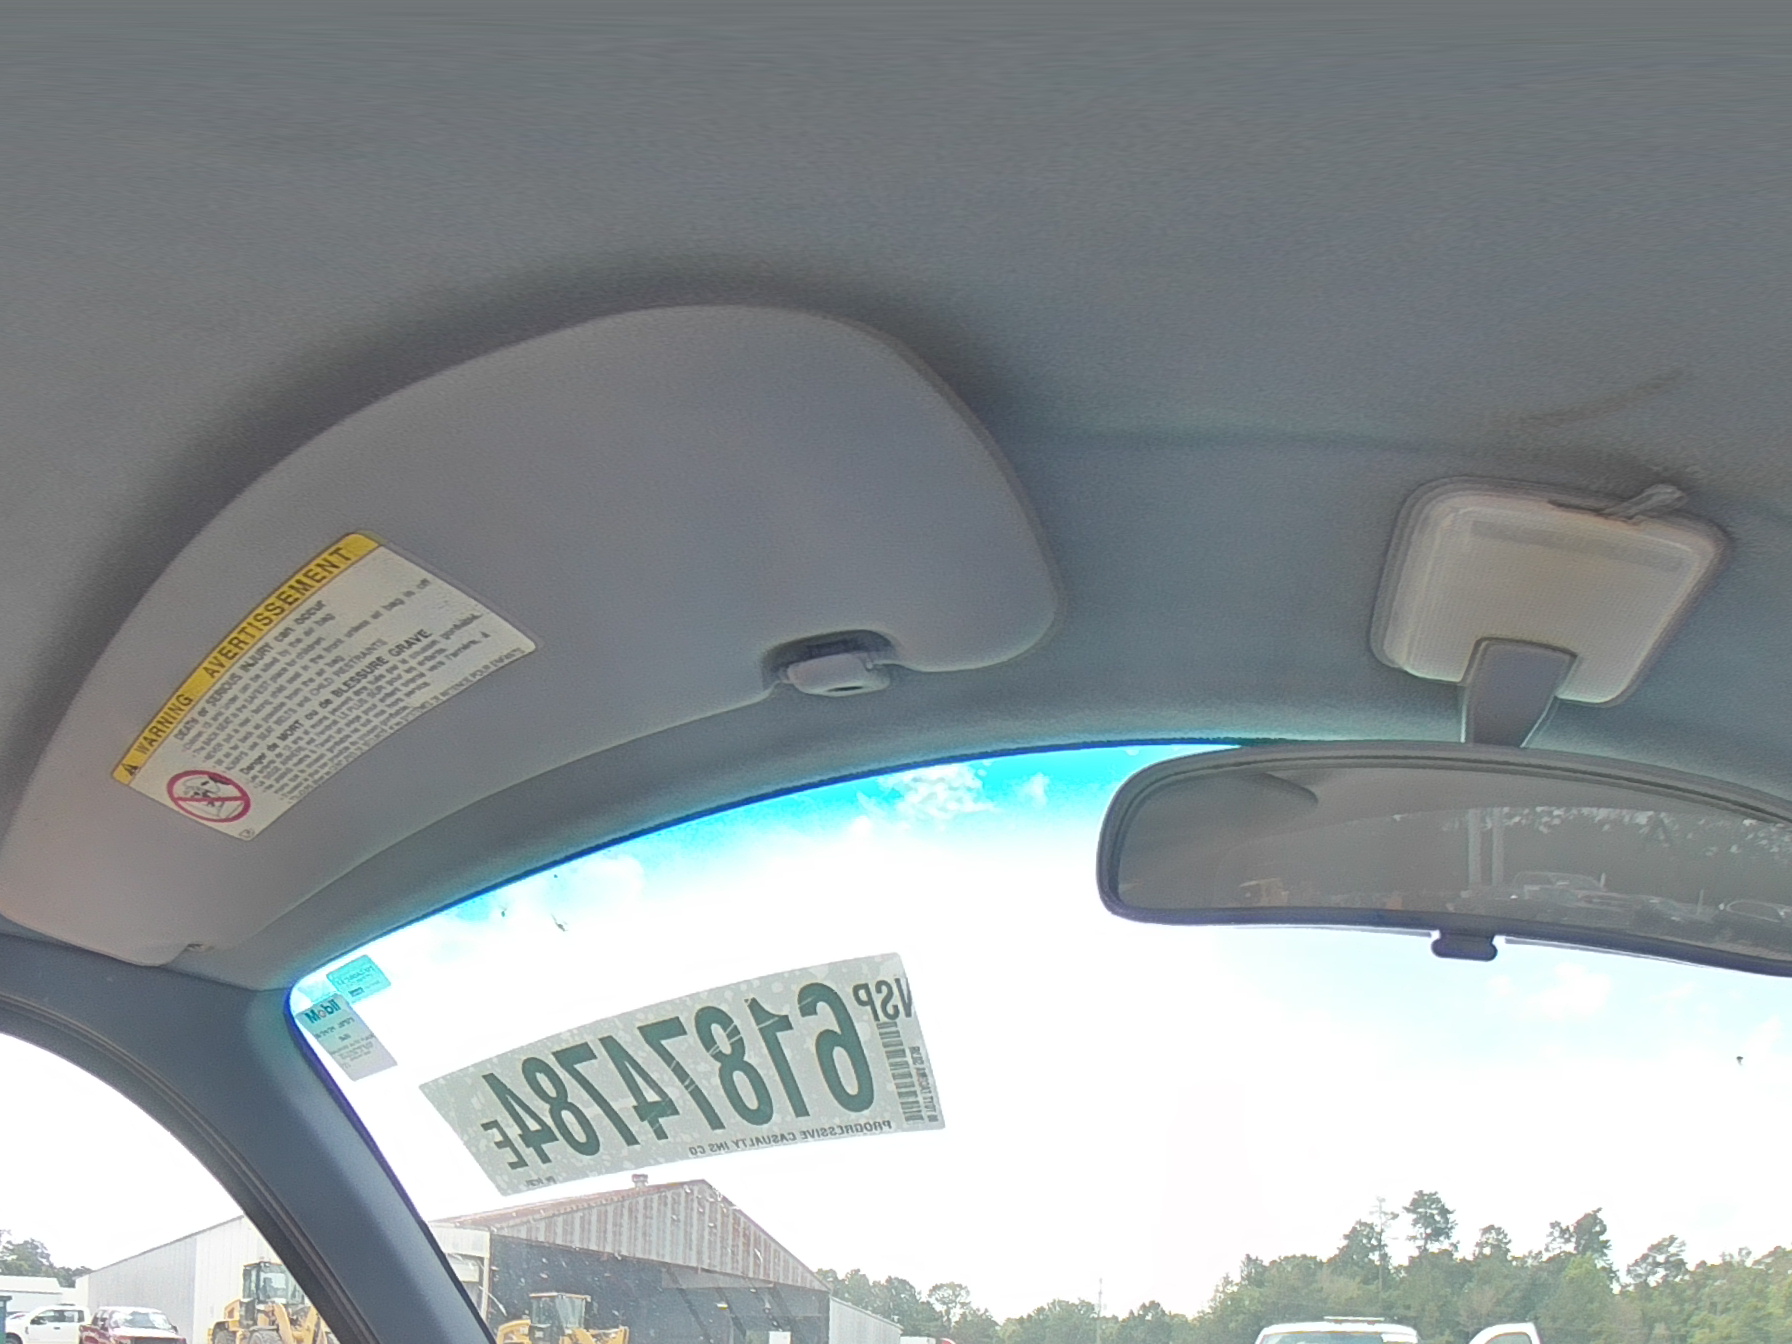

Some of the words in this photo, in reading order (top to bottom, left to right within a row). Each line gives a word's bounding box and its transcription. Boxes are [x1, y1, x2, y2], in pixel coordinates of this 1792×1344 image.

[134, 693, 195, 756] WARNING
[203, 546, 354, 680] AVERTISSEMENT
[205, 670, 241, 708] SERIOUS
[239, 640, 272, 675] INJURY
[274, 624, 294, 644] can
[294, 598, 325, 627] occur
[330, 649, 388, 703] BLESSURE
[388, 623, 431, 661] GRAVE
[304, 999, 341, 1023] Mobil
